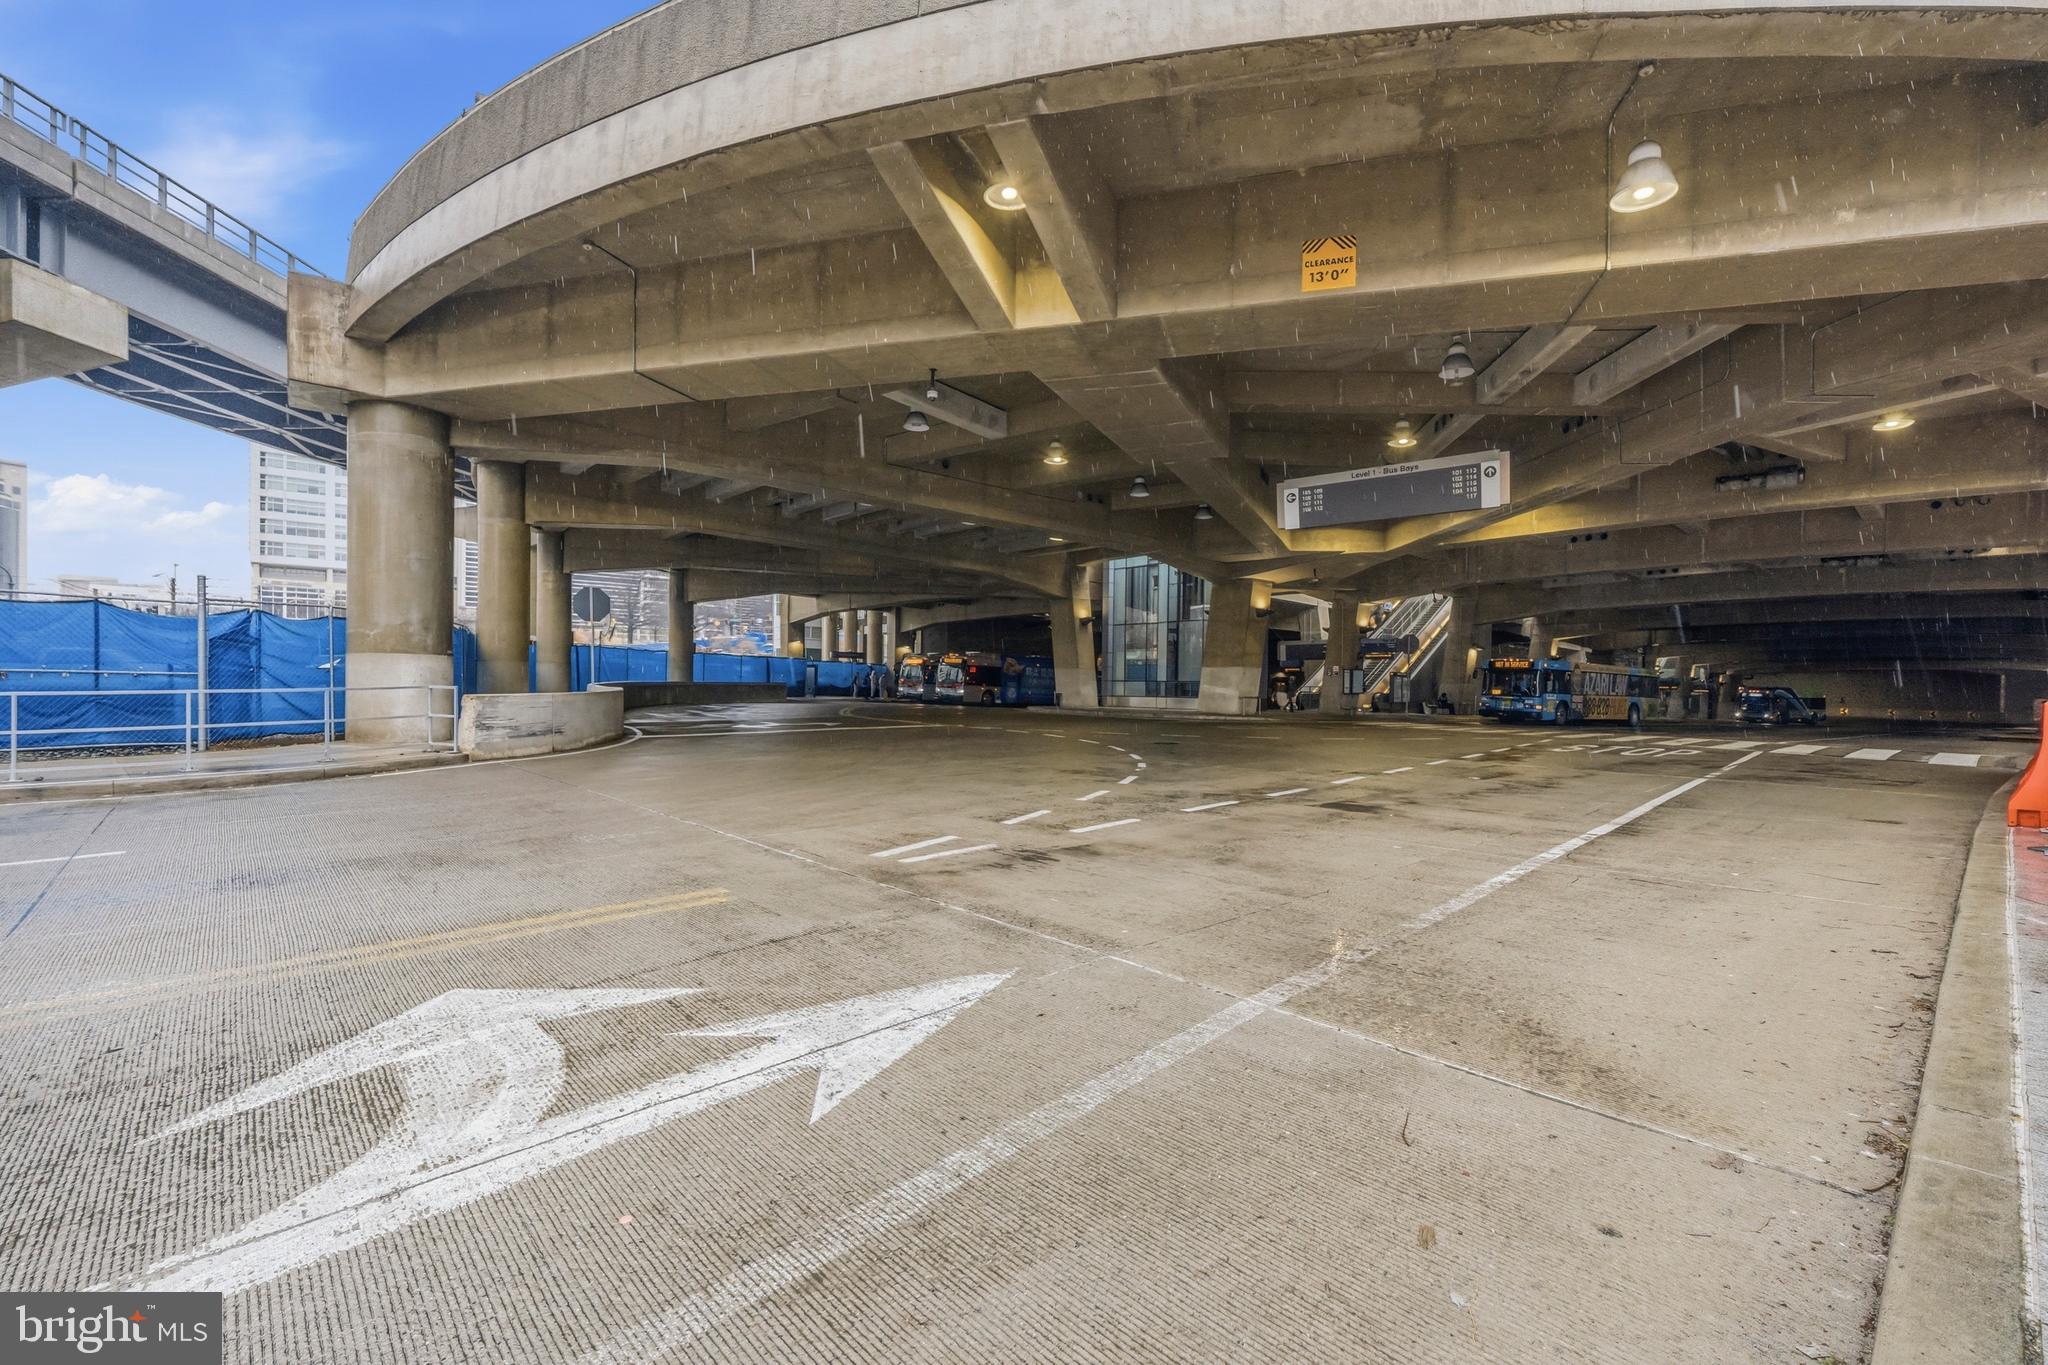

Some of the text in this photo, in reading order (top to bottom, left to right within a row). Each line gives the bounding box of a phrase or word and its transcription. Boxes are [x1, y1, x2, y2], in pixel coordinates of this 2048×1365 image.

[1305, 256, 1354, 268] CLEARANCE
[1351, 470, 1370, 479] Level
[1383, 467, 1398, 475] Bus
[1400, 464, 1419, 473] Bays
[1584, 672, 1628, 696] AZARI LAW
[1551, 744, 1702, 757] STOP
